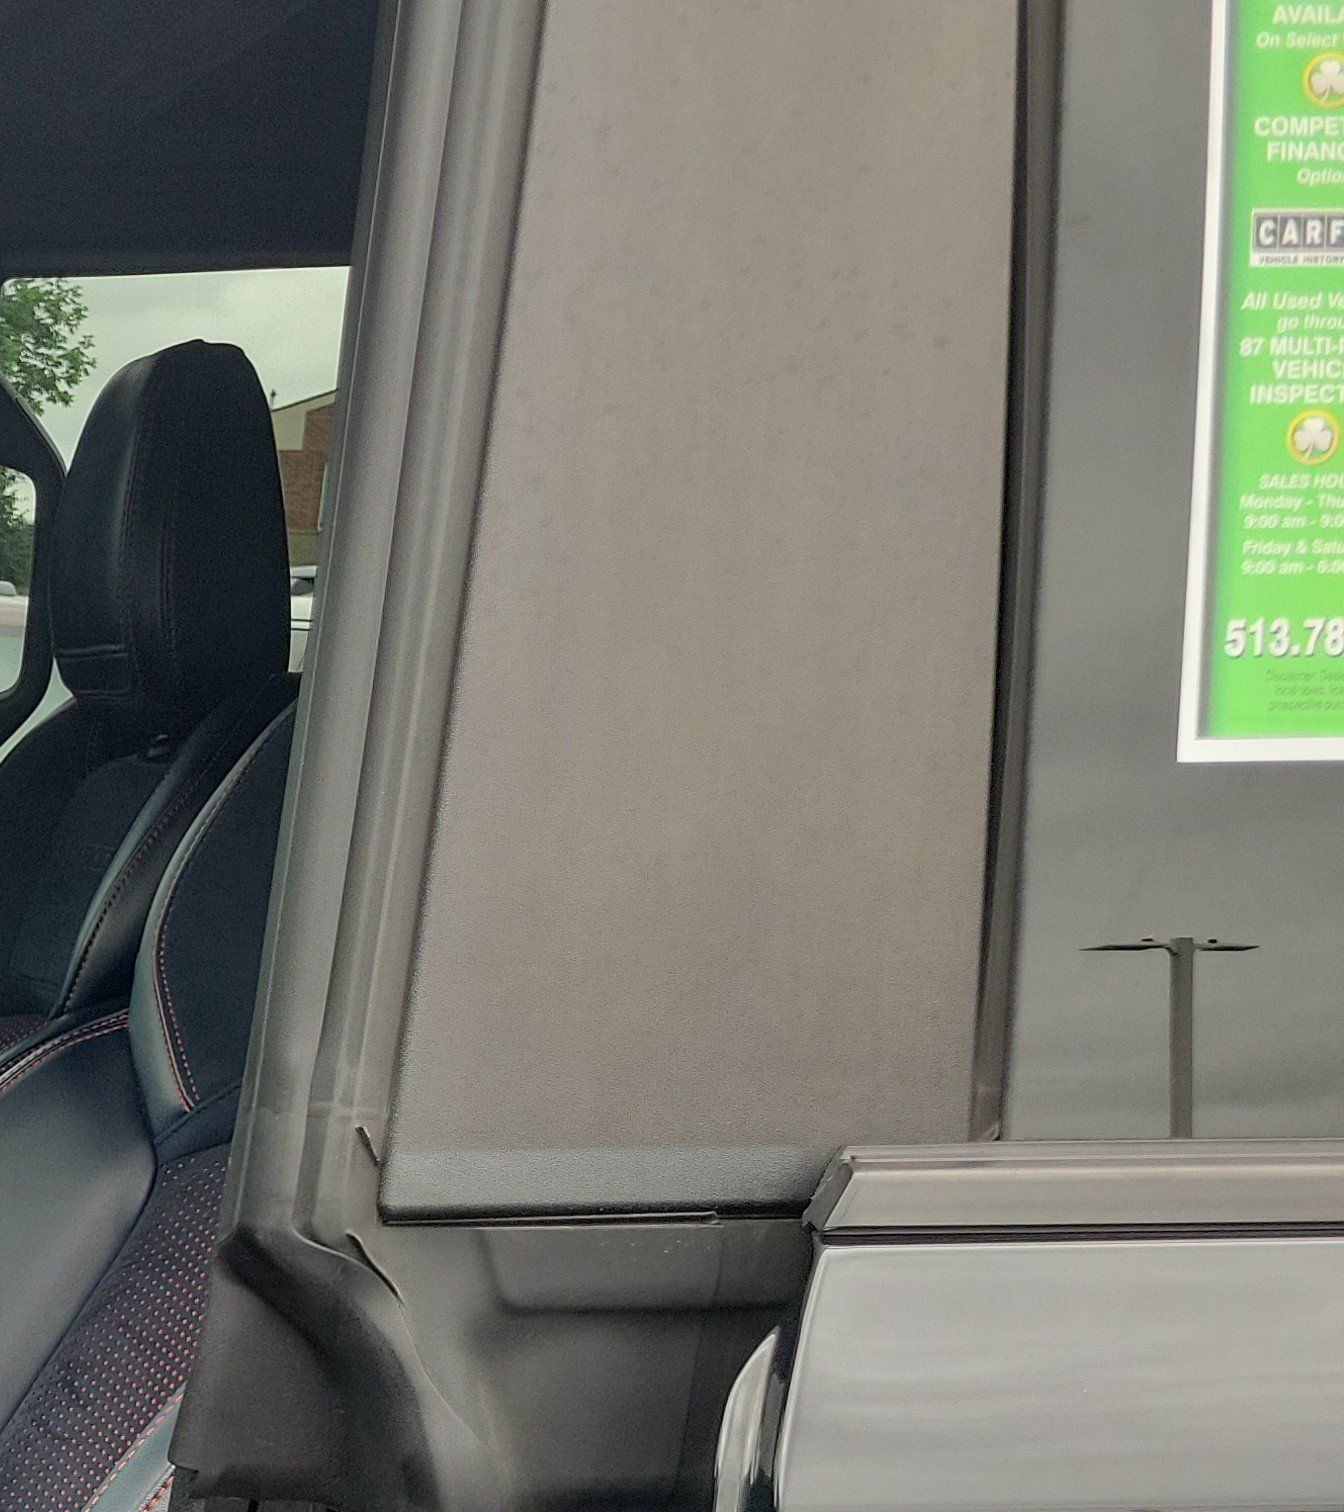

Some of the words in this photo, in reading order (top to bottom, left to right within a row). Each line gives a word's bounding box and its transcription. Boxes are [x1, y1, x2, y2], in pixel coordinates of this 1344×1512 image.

[1256, 31, 1281, 48] On
[1286, 31, 1337, 49] Select
[1241, 291, 1268, 310] All
[1272, 291, 1323, 310] Used
[1276, 317, 1299, 333] go
[1239, 337, 1263, 356] 87
